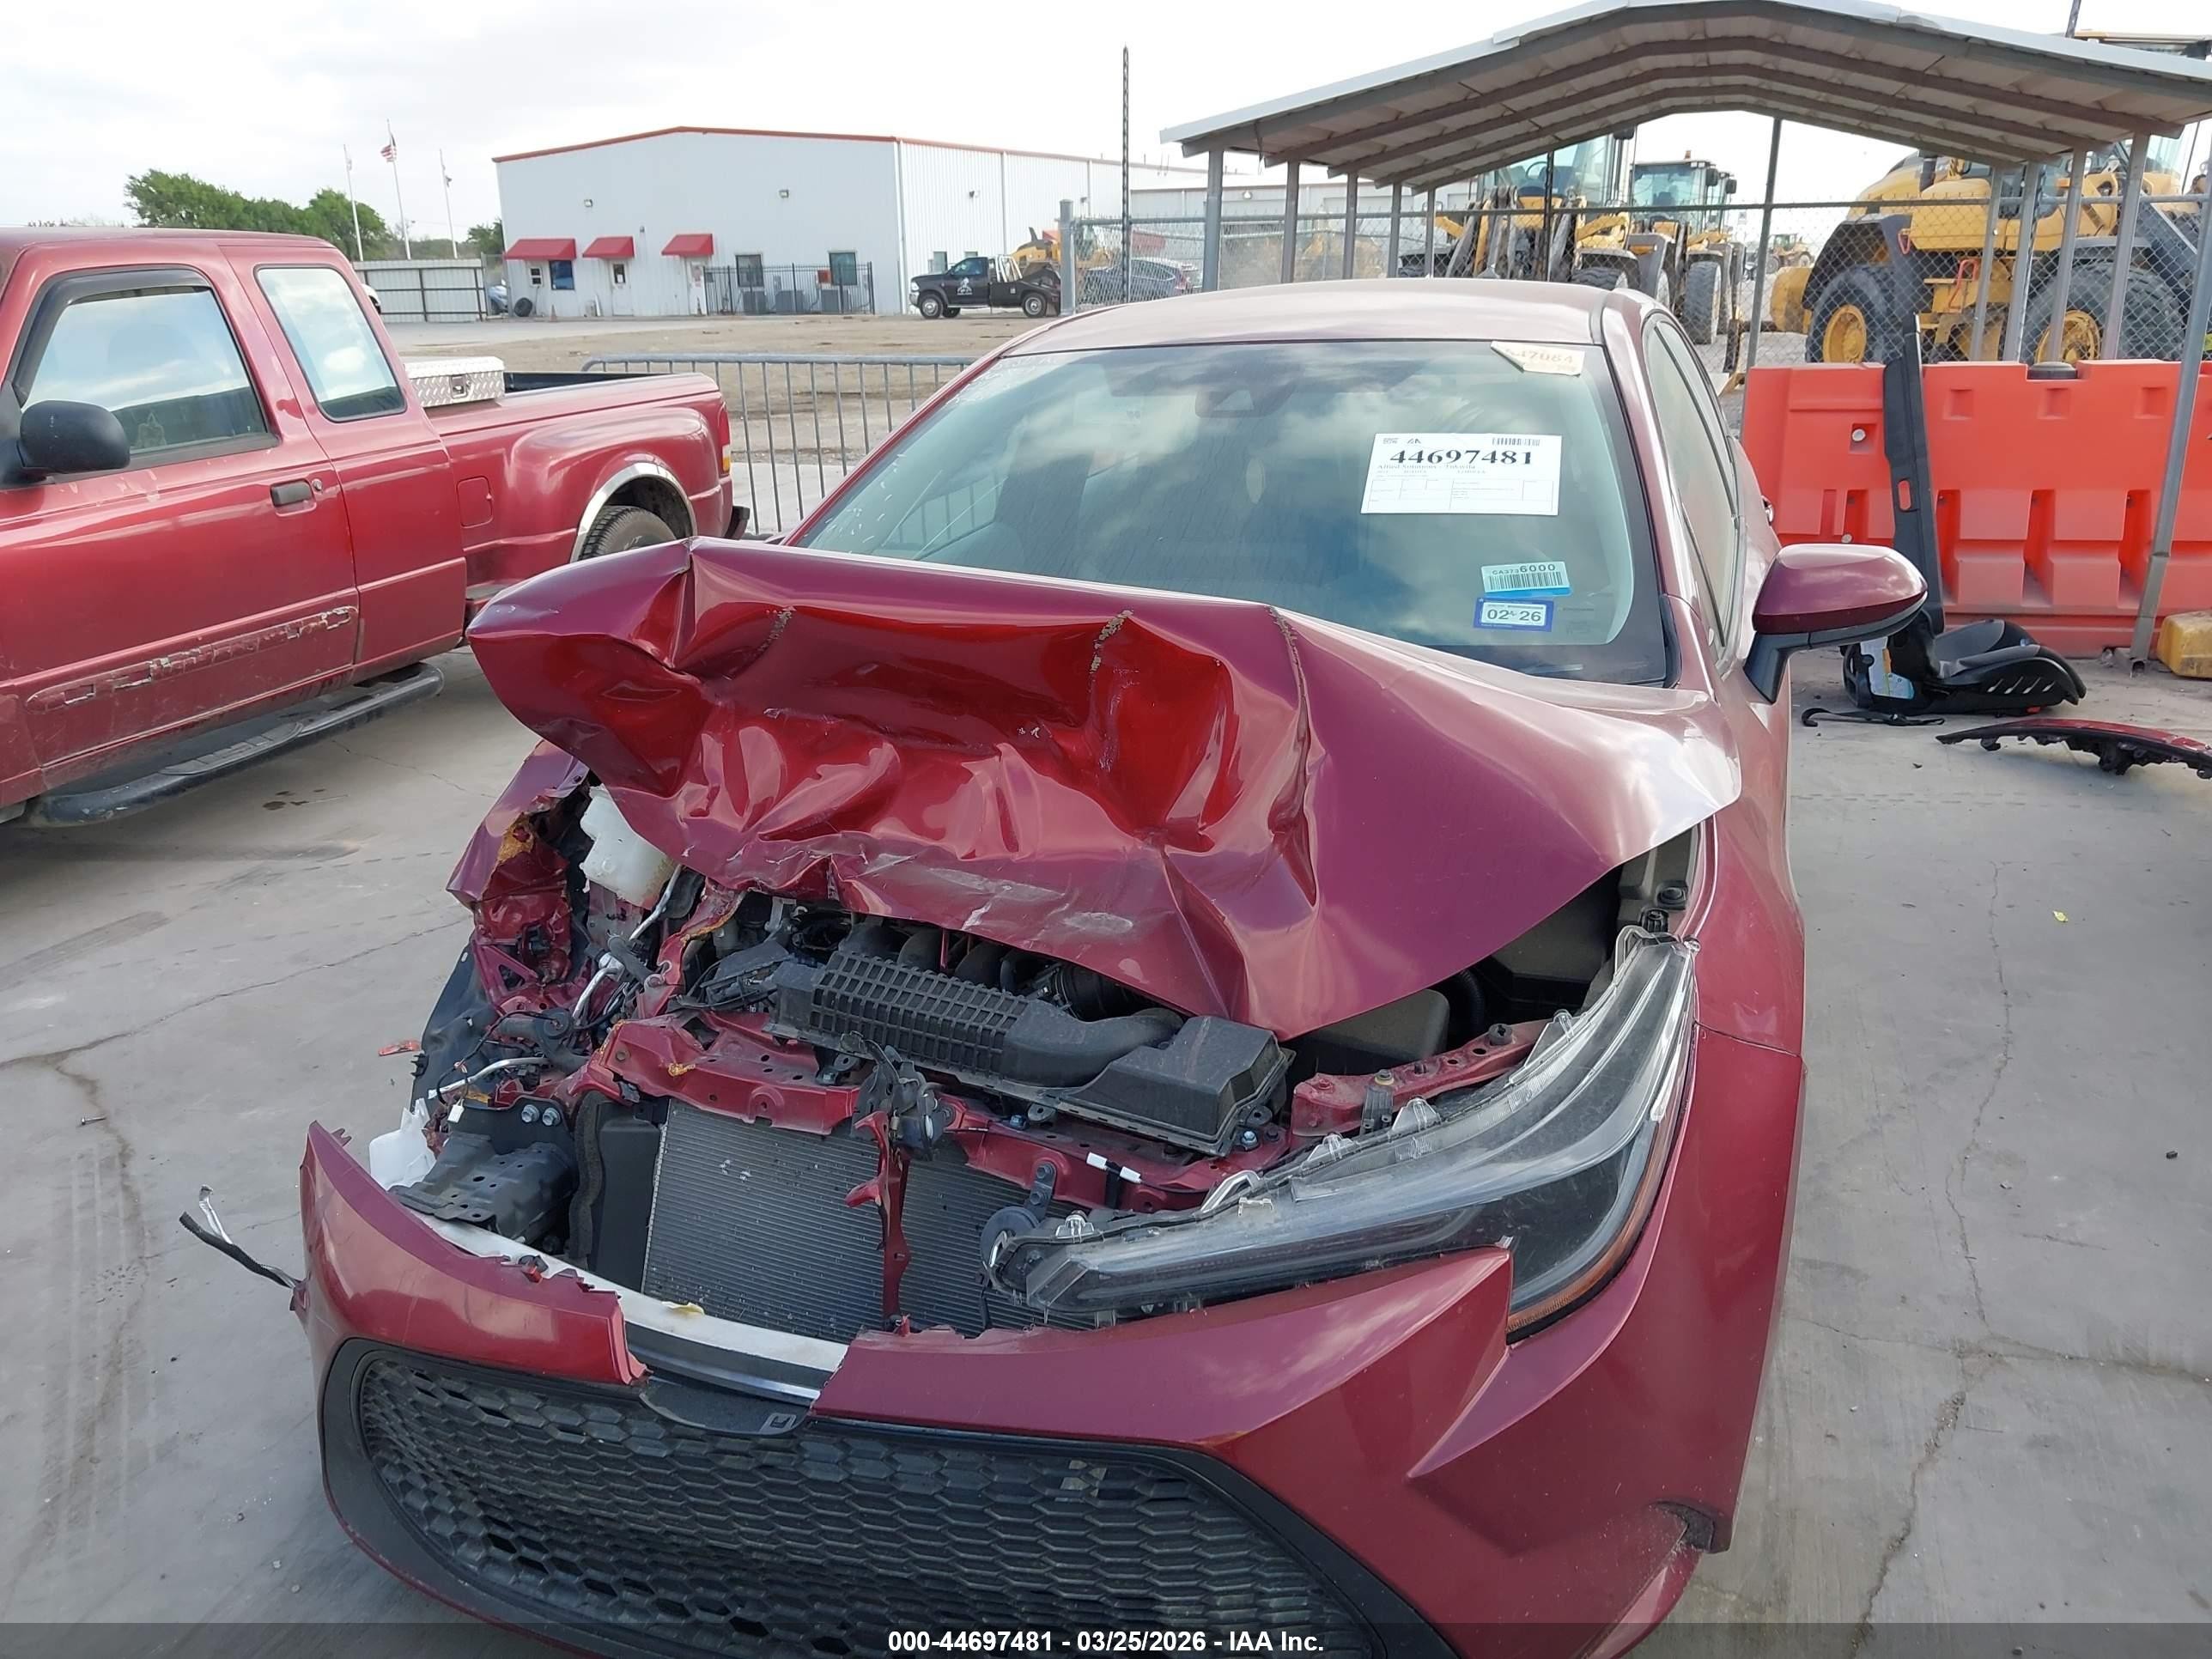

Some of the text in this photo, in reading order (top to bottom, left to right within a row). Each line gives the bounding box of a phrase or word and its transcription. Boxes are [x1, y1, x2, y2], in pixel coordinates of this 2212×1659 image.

[1389, 450, 1531, 465] 44697481
[1486, 608, 1542, 622] 02 26
